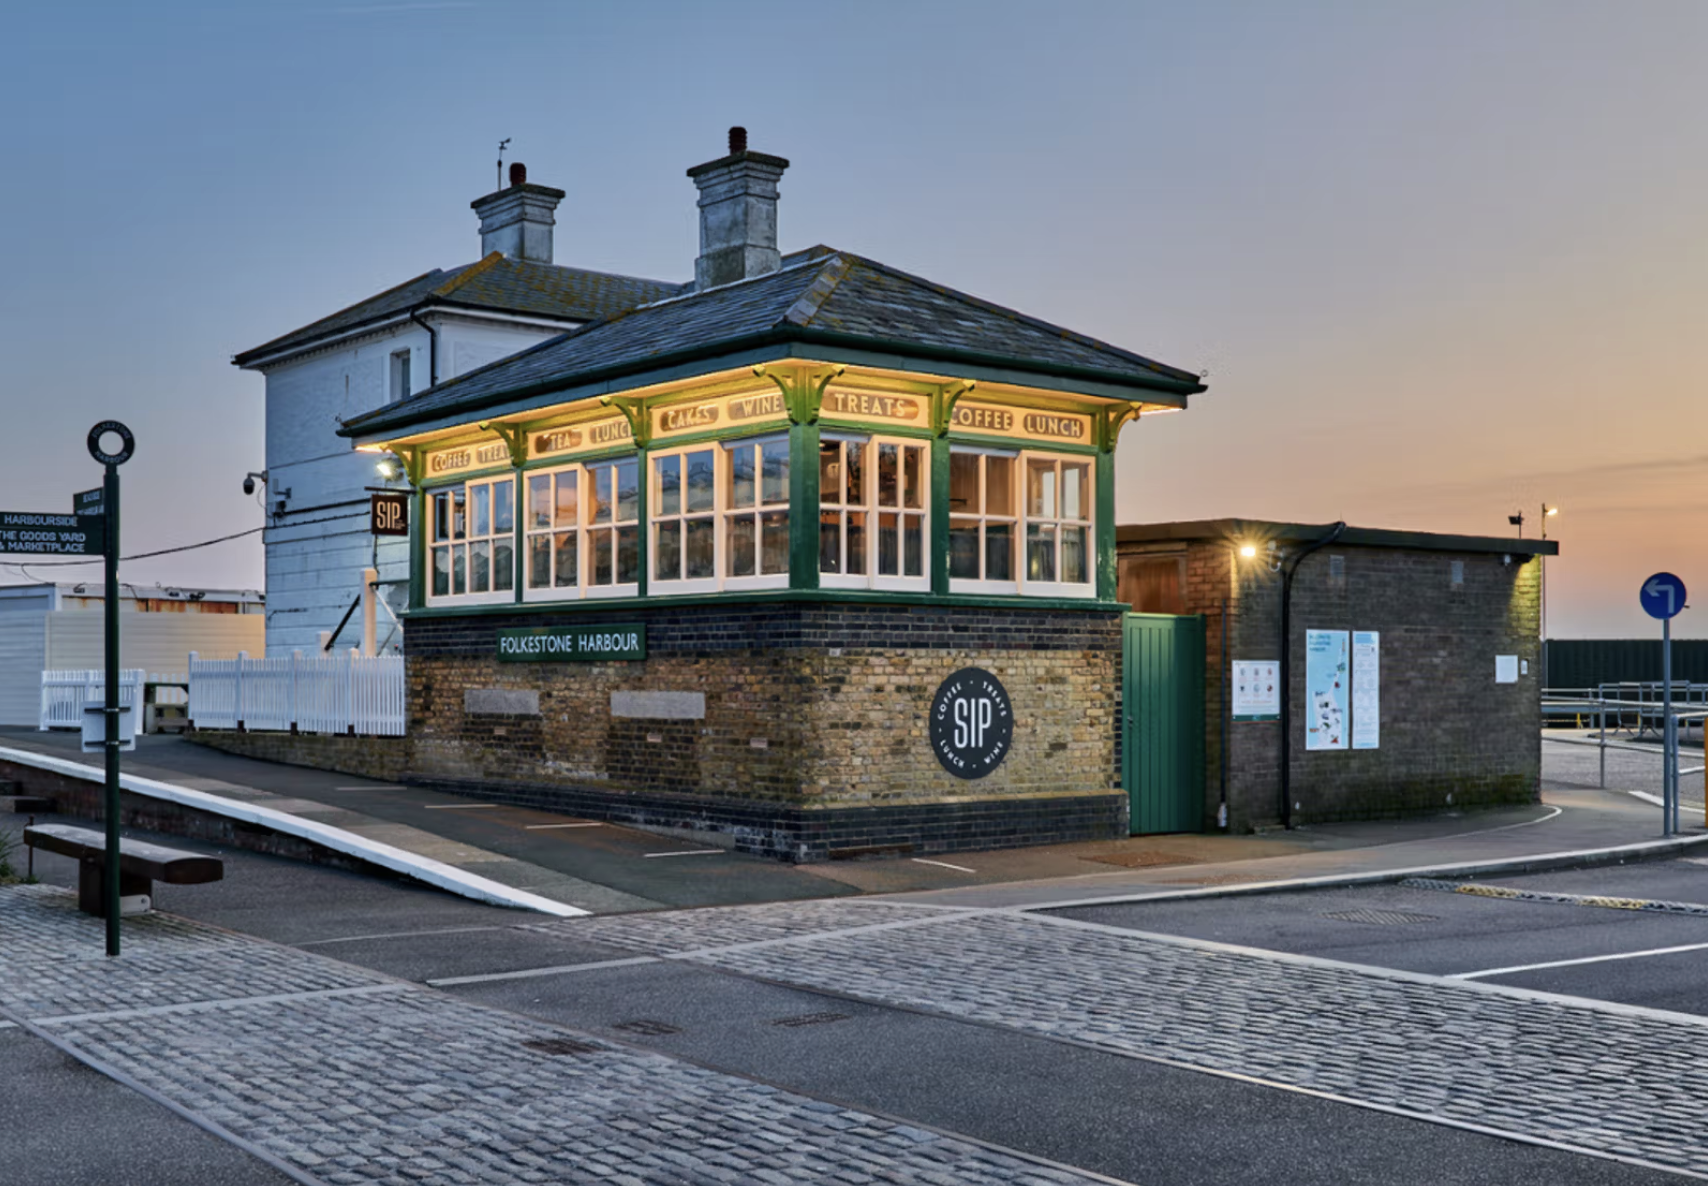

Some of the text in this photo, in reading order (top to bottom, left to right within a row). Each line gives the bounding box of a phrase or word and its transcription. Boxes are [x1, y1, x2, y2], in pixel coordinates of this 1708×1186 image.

[667, 395, 780, 429] CAKES WINE
[834, 393, 905, 417] TREATS
[1026, 415, 1080, 437] LUNCH
[551, 431, 571, 450] TEA
[434, 452, 470, 470] COFFEE
[4, 514, 78, 527] HARBOURSIDE
[376, 501, 401, 529] SIP
[8, 541, 85, 553] MARKETPLACE
[19, 530, 57, 542] GOODS
[58, 532, 86, 543] YARD
[500, 632, 639, 654] FOLKESTONE HARBOUR
[937, 682, 962, 720] COFFEE
[982, 681, 1007, 717] TREATS
[954, 698, 992, 749] SIP
[940, 739, 965, 768] LUNCH
[984, 741, 1003, 764] WINE
